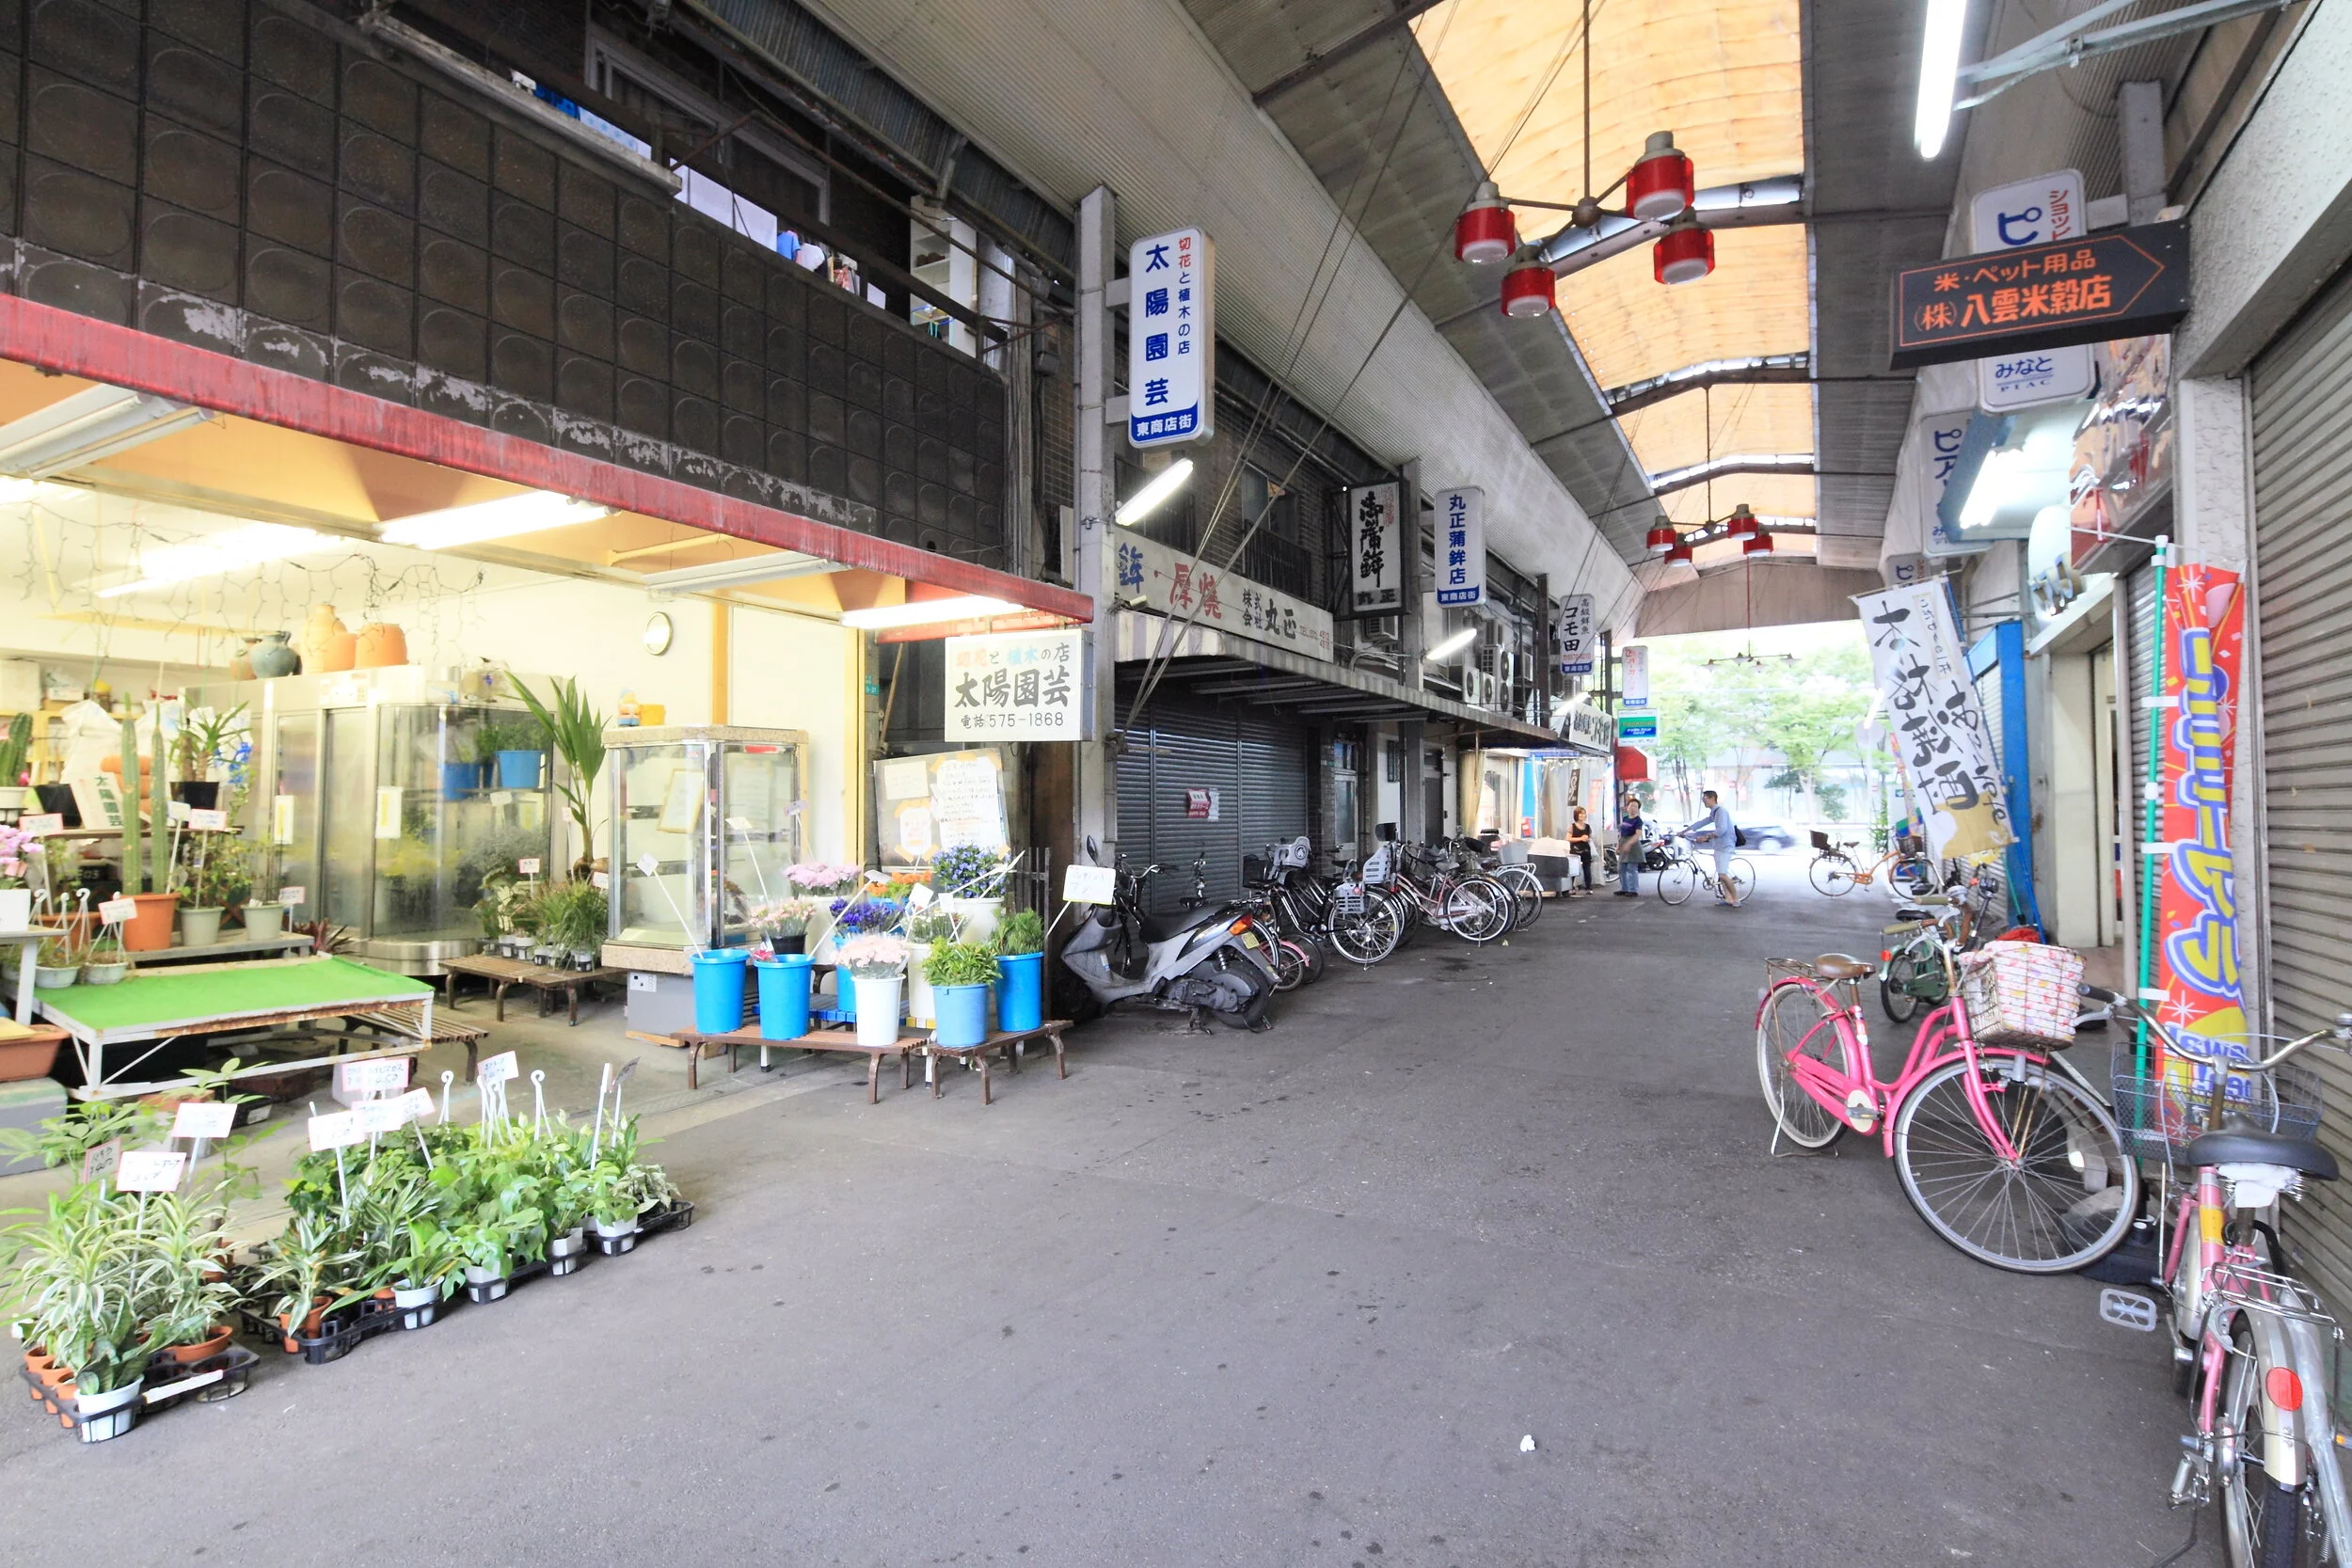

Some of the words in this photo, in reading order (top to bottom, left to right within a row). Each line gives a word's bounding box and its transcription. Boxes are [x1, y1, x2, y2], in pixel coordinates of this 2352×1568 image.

[1178, 237, 1191, 356] 切花と植木の店
[1145, 244, 1169, 406] 太陽園芸
[1995, 356, 2054, 379] みなと
[1136, 414, 1192, 437] 東商店街
[1449, 494, 1467, 585] 丸正蒲鉾店
[1358, 589, 1396, 606] 丸正
[1441, 592, 1476, 602] 東商店街
[1264, 599, 1297, 640] 丸正
[1564, 607, 1581, 652] コモ田
[954, 665, 1072, 707] 太陽園芸
[961, 713, 985, 729] 電話
[989, 712, 1064, 728] 575-1868
